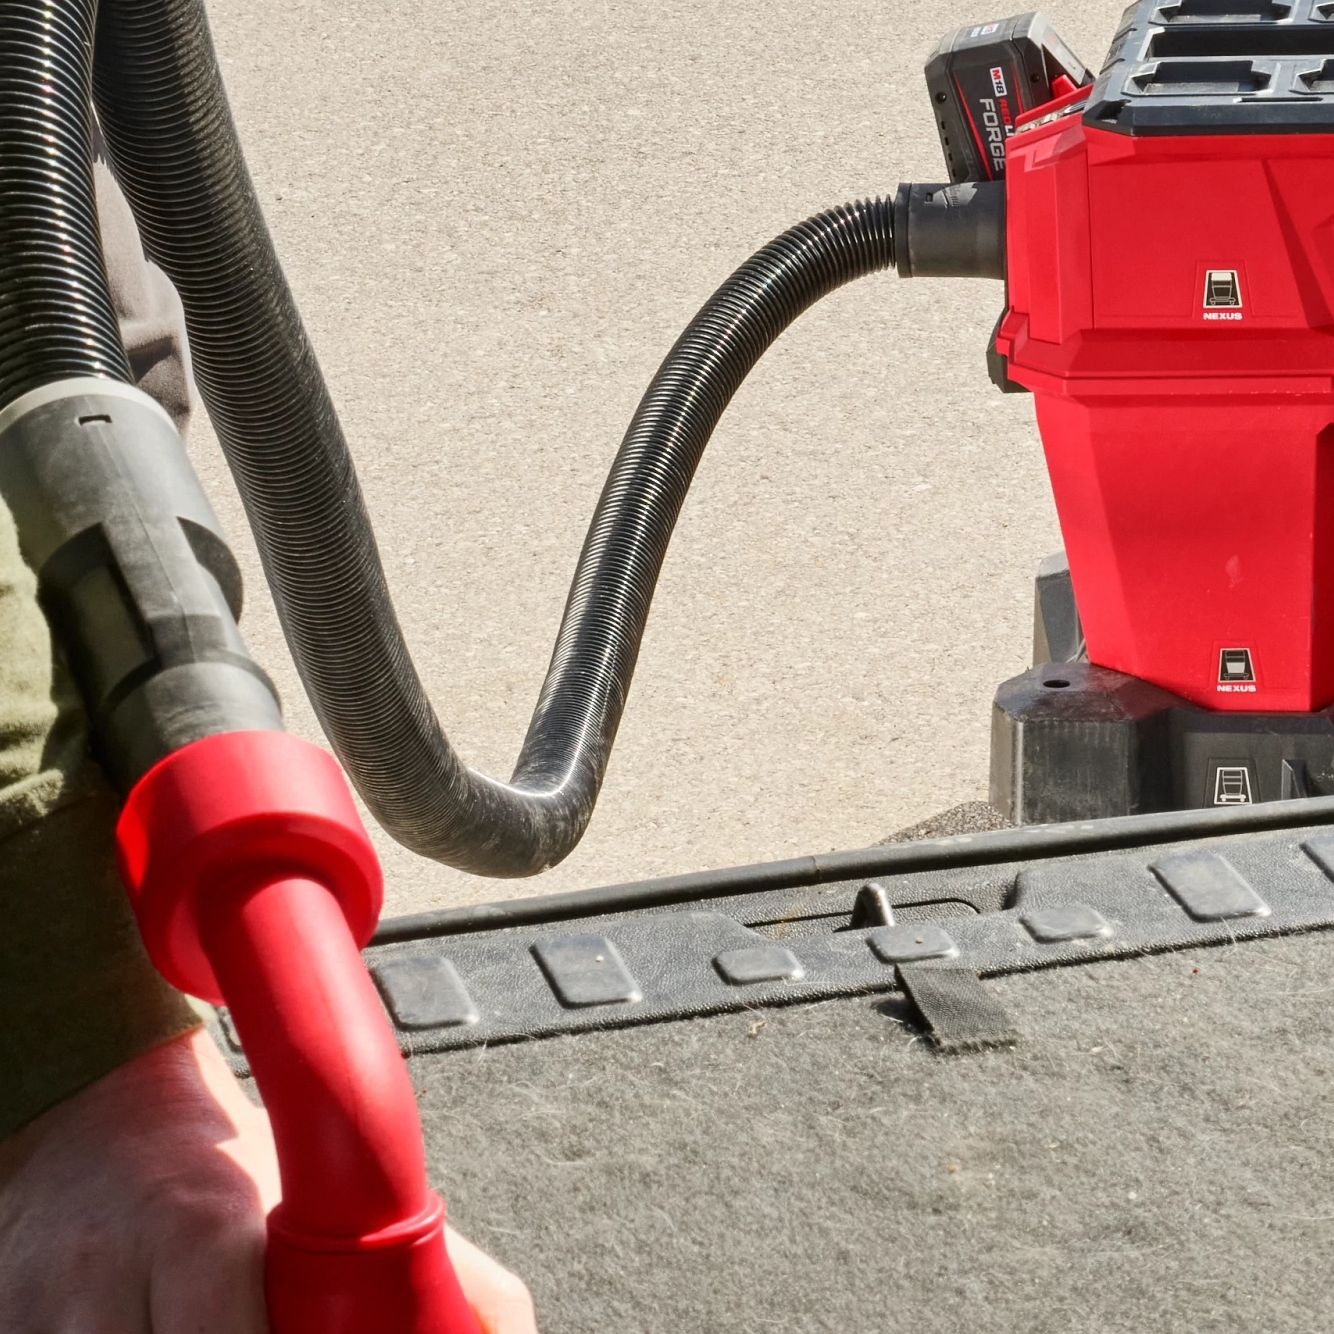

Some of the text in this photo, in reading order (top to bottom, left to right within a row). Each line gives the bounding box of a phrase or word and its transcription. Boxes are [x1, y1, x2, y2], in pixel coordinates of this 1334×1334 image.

[992, 69, 1005, 94] M18
[980, 99, 1005, 171] FORGE
[1203, 312, 1243, 320] NEXUS
[1217, 684, 1257, 692] NEXUS
